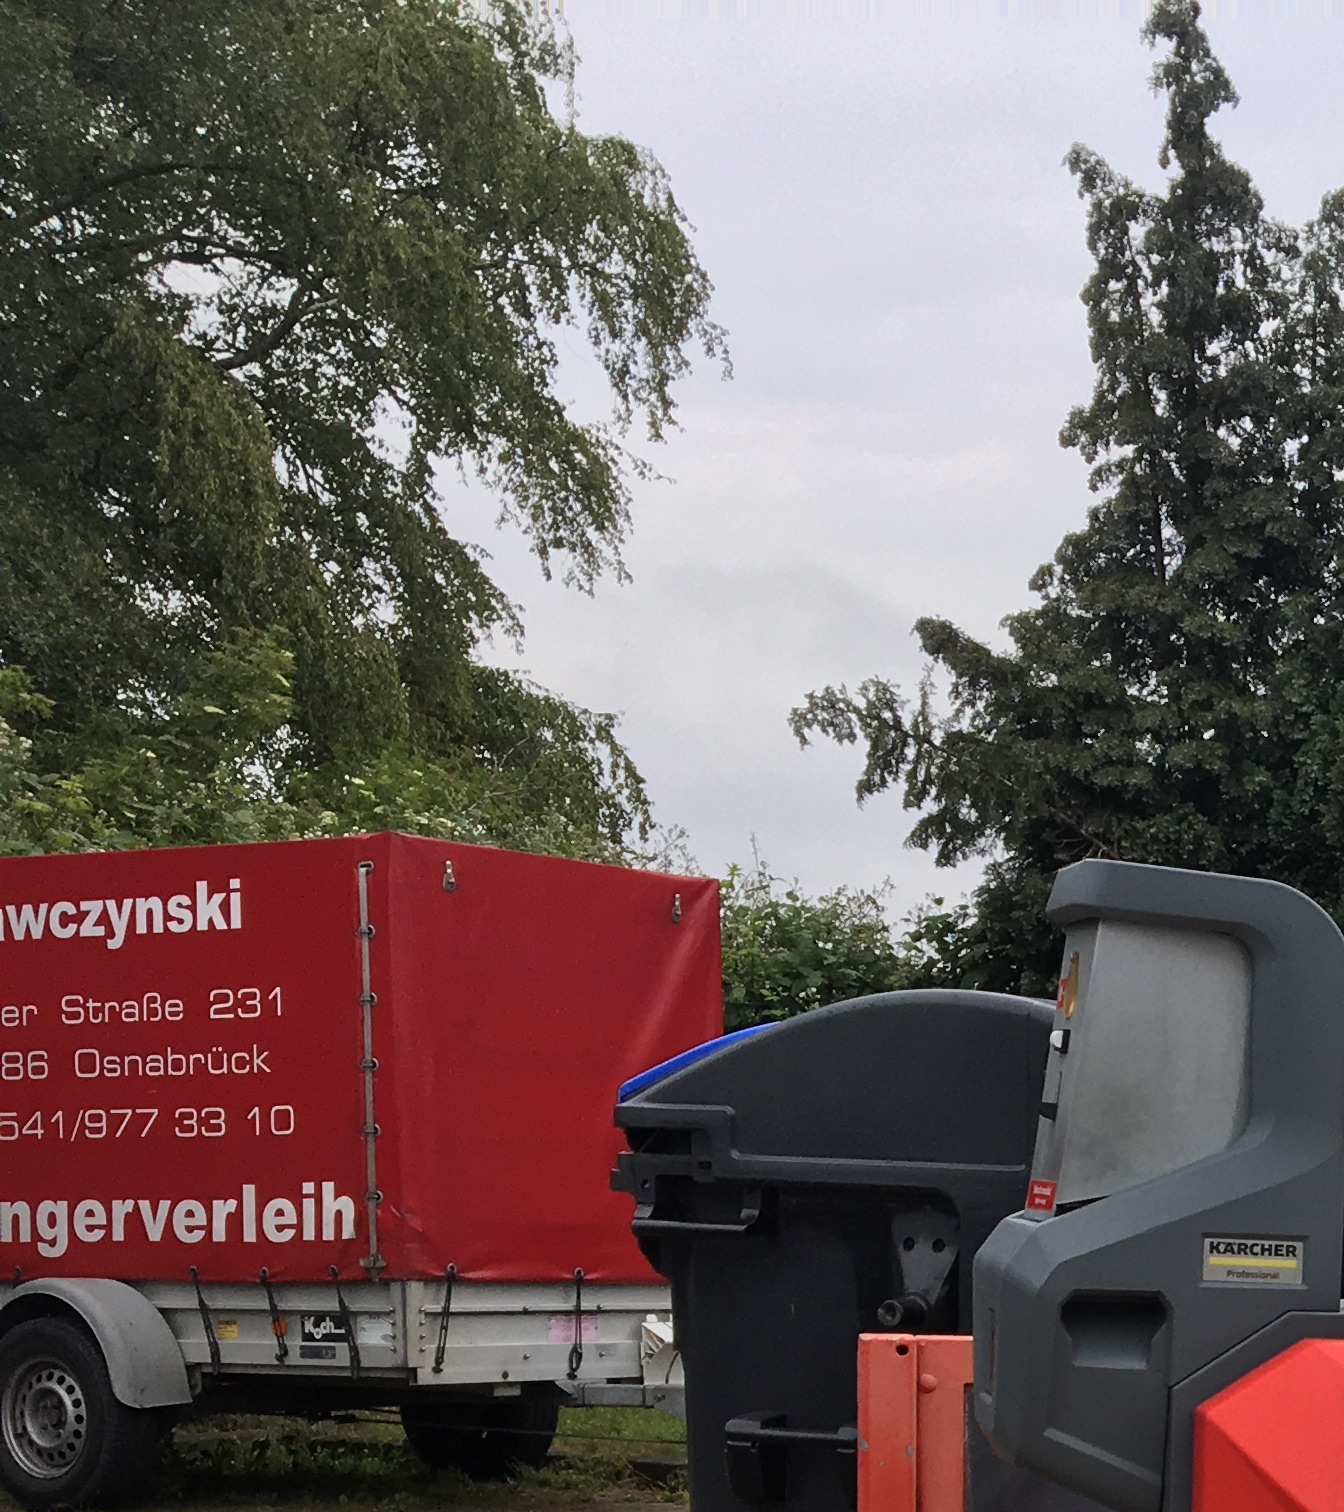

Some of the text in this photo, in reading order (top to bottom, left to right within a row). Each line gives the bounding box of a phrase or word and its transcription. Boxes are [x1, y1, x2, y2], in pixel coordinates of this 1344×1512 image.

[0, 986, 283, 1027] er Straße 231
[0, 1044, 272, 1081] 86 Osnabrück
[0, 1104, 295, 1142] 541/977 33 10
[0, 1181, 356, 1258] ngerverleih
[1208, 1240, 1298, 1258] KÄRCHER
[1226, 1269, 1280, 1280] Professional
